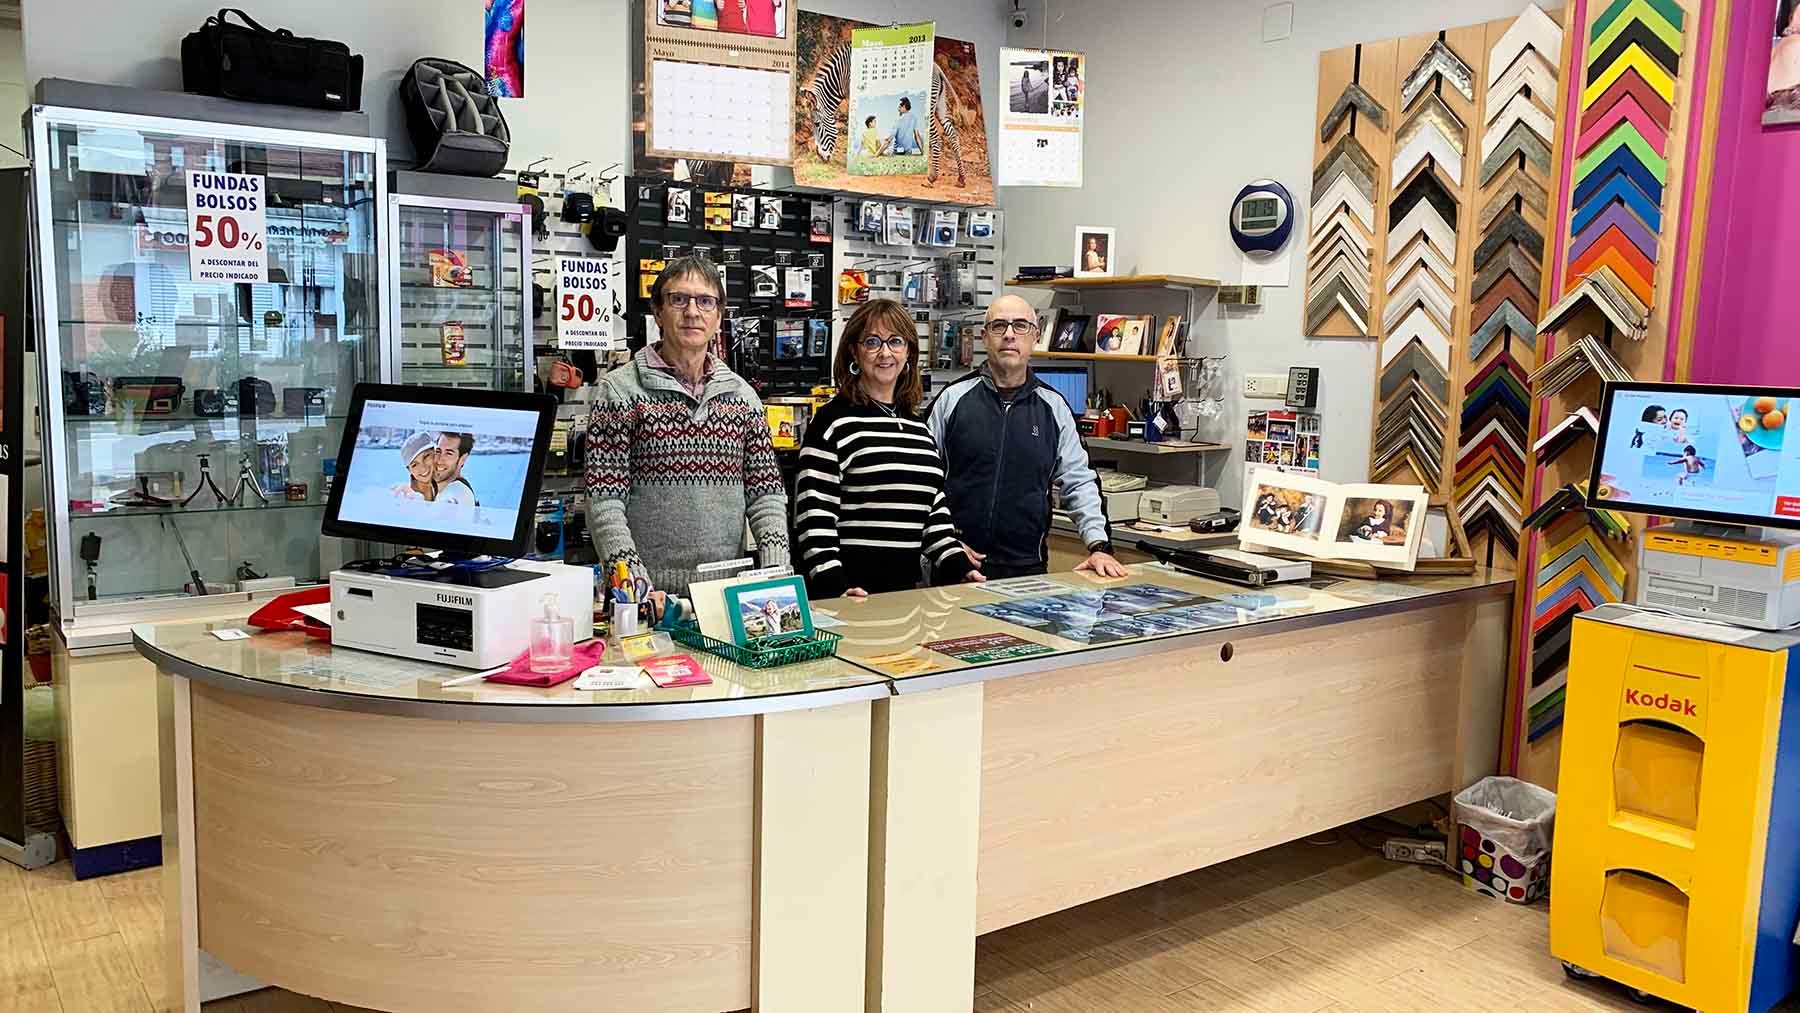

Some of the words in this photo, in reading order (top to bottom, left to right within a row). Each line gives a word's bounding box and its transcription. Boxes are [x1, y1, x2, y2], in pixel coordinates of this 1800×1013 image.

[908, 35, 926, 44] 2013
[653, 48, 675, 57] Mayo
[772, 60, 790, 68] 2014
[193, 174, 259, 192] FUNDAS
[196, 194, 257, 211] BOLSOS
[194, 214, 262, 250] 50%
[562, 260, 608, 274] FUNDAS
[564, 276, 607, 290] BOLSOS
[561, 294, 610, 322] 50%
[436, 593, 473, 606] FUJIFILM
[1626, 688, 1697, 717] Kodak
